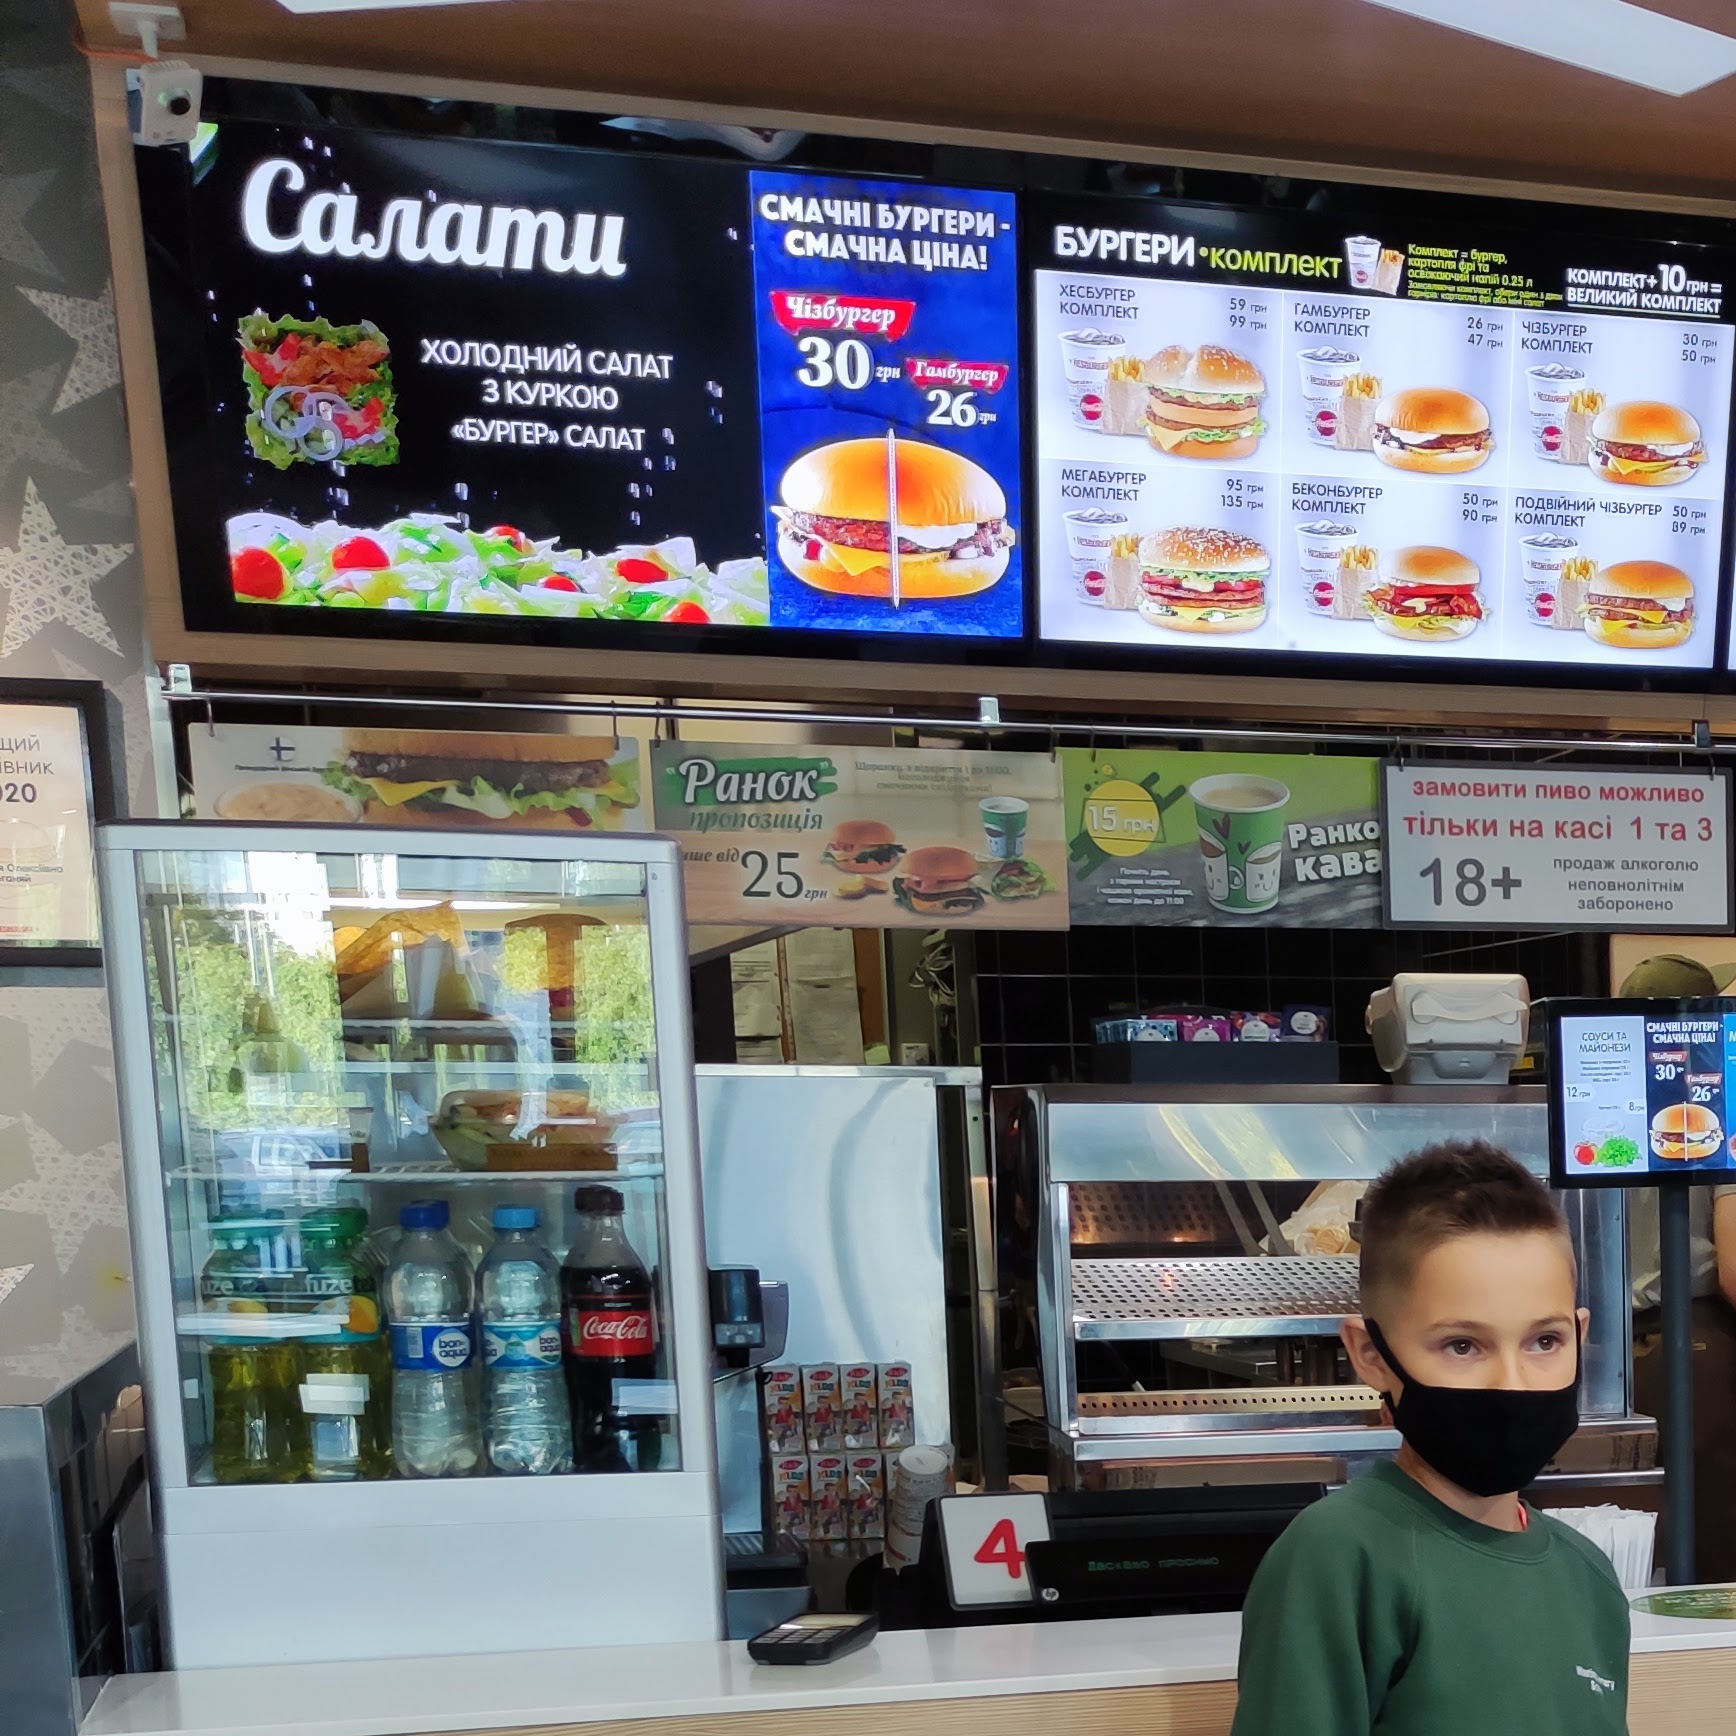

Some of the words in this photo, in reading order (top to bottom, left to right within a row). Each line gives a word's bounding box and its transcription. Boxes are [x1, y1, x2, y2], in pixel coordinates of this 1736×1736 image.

[241, 157, 628, 276] Салати
[760, 194, 870, 227] СМАЧНІ
[877, 204, 994, 237] БУРГЕРИ
[785, 230, 906, 264] СМАЧНА
[913, 240, 987, 271] ЦІНА!
[1055, 225, 1194, 267] БУРГЕРИ
[1408, 244, 1458, 259] Комплект
[1658, 264, 1686, 292] 10
[1060, 284, 1135, 301] ХЕСБУРГЕР
[1568, 286, 1637, 307] ВЕЛИКИЙ
[1641, 291, 1721, 313] КОМПЛЕКТ
[1060, 302, 1138, 319] КОМПЛЕКТ
[1230, 298, 1246, 311] 59
[1295, 303, 1370, 320] ГАМБУРГЕР
[786, 296, 895, 332] Чізбургер
[1229, 315, 1246, 328] 99
[1295, 321, 1370, 337] КОМПЛЕКТ
[1468, 317, 1483, 330] 26
[1468, 334, 1483, 346] 47
[1521, 338, 1593, 355] КОМПЛЕКТ
[1682, 333, 1698, 345] 30
[421, 339, 582, 374] ХОЛОДНИЙ
[588, 352, 673, 379] САЛАТ
[798, 336, 874, 390] 30
[876, 366, 900, 383] грн
[1681, 350, 1697, 362] 50
[915, 362, 998, 385] Гамбургер
[482, 379, 499, 402] З
[506, 380, 618, 410] КУРКОЮ
[927, 390, 979, 426] 26
[452, 418, 559, 444] «БУРГЕР»
[565, 425, 645, 450] САЛАТ
[1062, 469, 1146, 485] МЕГАБУРГЕР
[1227, 479, 1242, 491] 95
[1062, 485, 1139, 501] КОМПЛЕКТ
[1292, 483, 1383, 499] БЕКОНБУРГЕР
[1463, 493, 1478, 505] 50
[1221, 496, 1242, 507] 135
[1292, 499, 1366, 514] КОМПЛЕКТ
[1516, 496, 1595, 513] ПОДВІЙНИЙ
[1600, 501, 1662, 516] ЧІЗБУРГЕР
[1462, 509, 1478, 521] 90
[1672, 505, 1687, 517] 50
[1515, 513, 1585, 527] КОМПЛЕКТ
[1414, 780, 1526, 798] замовити
[1535, 784, 1590, 800] пиво
[1600, 785, 1704, 802] можливо
[690, 808, 822, 834] пропозиція
[1089, 806, 1117, 831] 15
[1403, 810, 1497, 837] тільки
[1510, 818, 1543, 838] на
[1555, 815, 1611, 840] касі
[1630, 817, 1641, 840] 1
[1655, 821, 1686, 840] та
[1698, 817, 1712, 841] 3
[1554, 857, 1614, 872] продаж
[1621, 858, 1699, 873] алкоголю
[717, 848, 739, 862] від
[741, 851, 803, 898] 25
[805, 889, 827, 901] грн
[1419, 857, 1522, 907] 18+
[1569, 879, 1684, 893] неповнолітнім
[1578, 897, 1673, 912] заборонено
[1582, 1032, 1614, 1041] СОУСИ
[1616, 1032, 1627, 1040] ТА
[1655, 1064, 1675, 1081] 30
[1566, 1086, 1577, 1098] 12
[1692, 1086, 1710, 1101] 26
[305, 1276, 352, 1293] fuze
[439, 1348, 467, 1360] aqua
[974, 1518, 1026, 1578] 4
